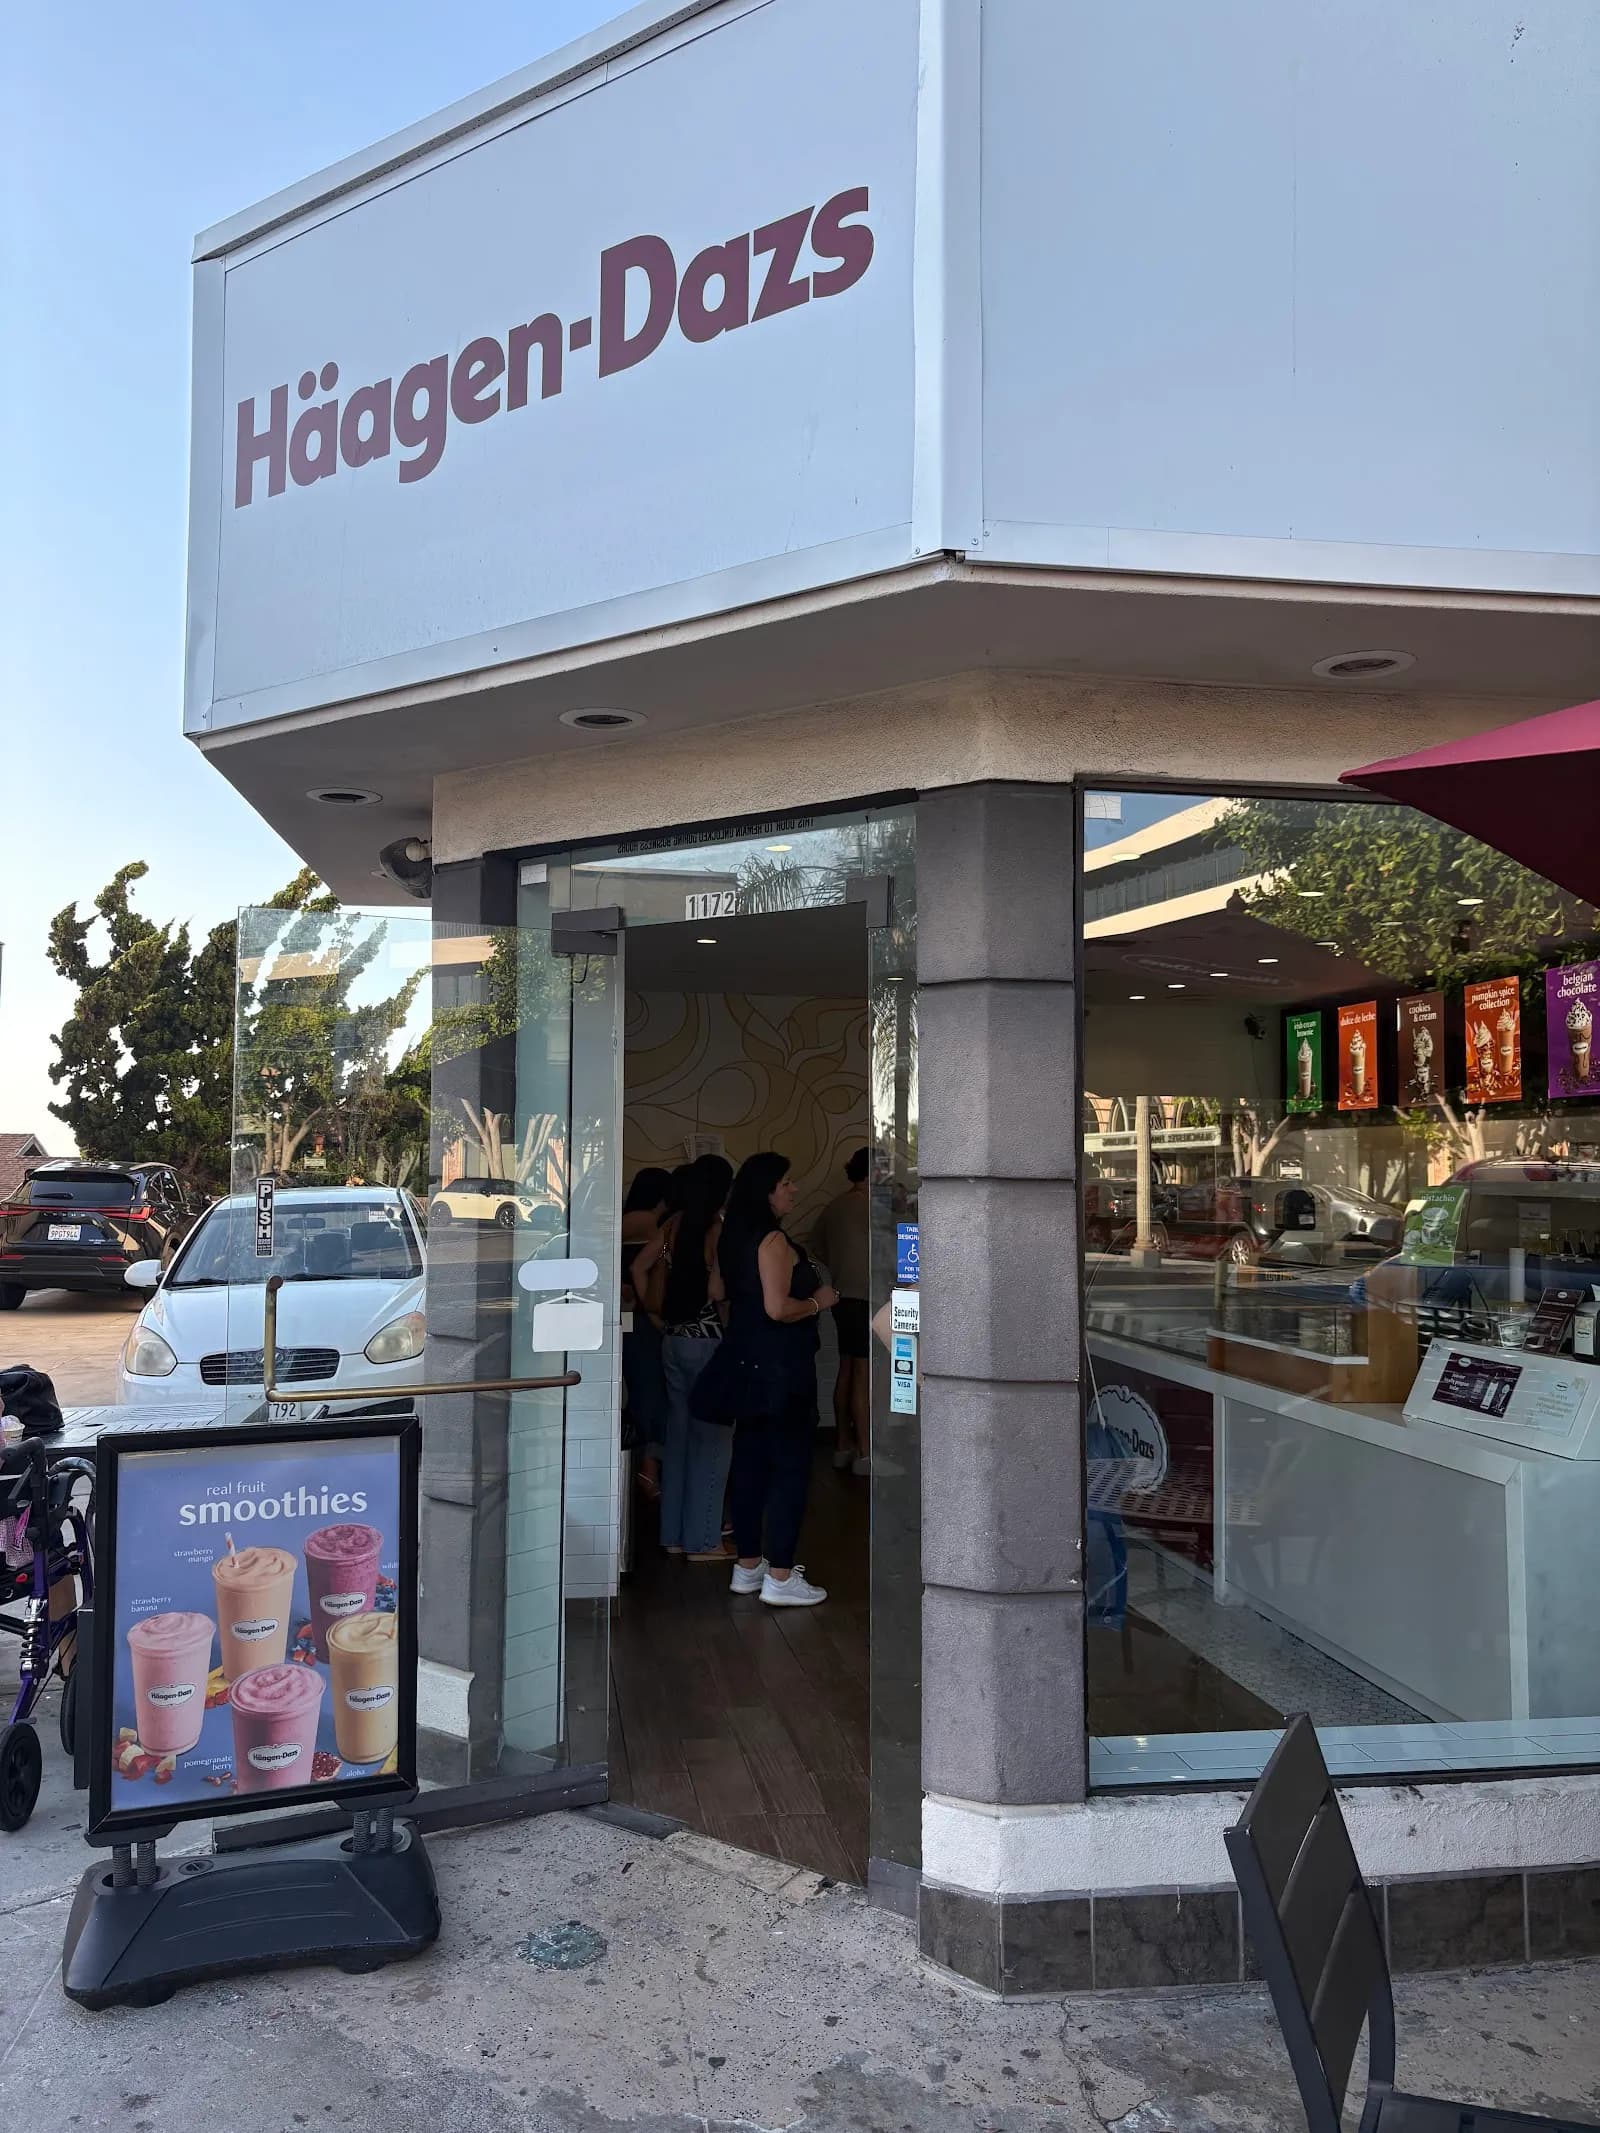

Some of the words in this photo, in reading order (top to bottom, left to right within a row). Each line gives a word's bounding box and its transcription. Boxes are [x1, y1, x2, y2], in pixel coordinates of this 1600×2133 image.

[234, 186, 875, 509] Häagen-Dazs
[688, 891, 735, 919] 1172
[1563, 972, 1593, 986] belgian
[1471, 988, 1498, 1004] pumpkin
[1499, 986, 1515, 998] spice
[1557, 983, 1597, 998] chocolate
[1409, 1002, 1431, 1014] cookies
[1479, 998, 1510, 1011] collection
[1419, 1012, 1437, 1021] cream
[259, 1185, 272, 1238] PUSH
[894, 1306, 919, 1320] Security
[894, 1319, 918, 1331] Cameras
[897, 1380, 911, 1388] VISA
[270, 1403, 296, 1418] 792
[206, 1482, 232, 1496] real
[237, 1480, 266, 1494] fruit
[179, 1485, 368, 1526] smoothies
[173, 1547, 214, 1559] strawberry
[188, 1555, 214, 1563] mango
[131, 1596, 172, 1606] strawberry
[131, 1603, 158, 1613] banana
[183, 1755, 232, 1768] pomegranate
[212, 1762, 232, 1771] berry
[346, 1768, 366, 1778] aloha
